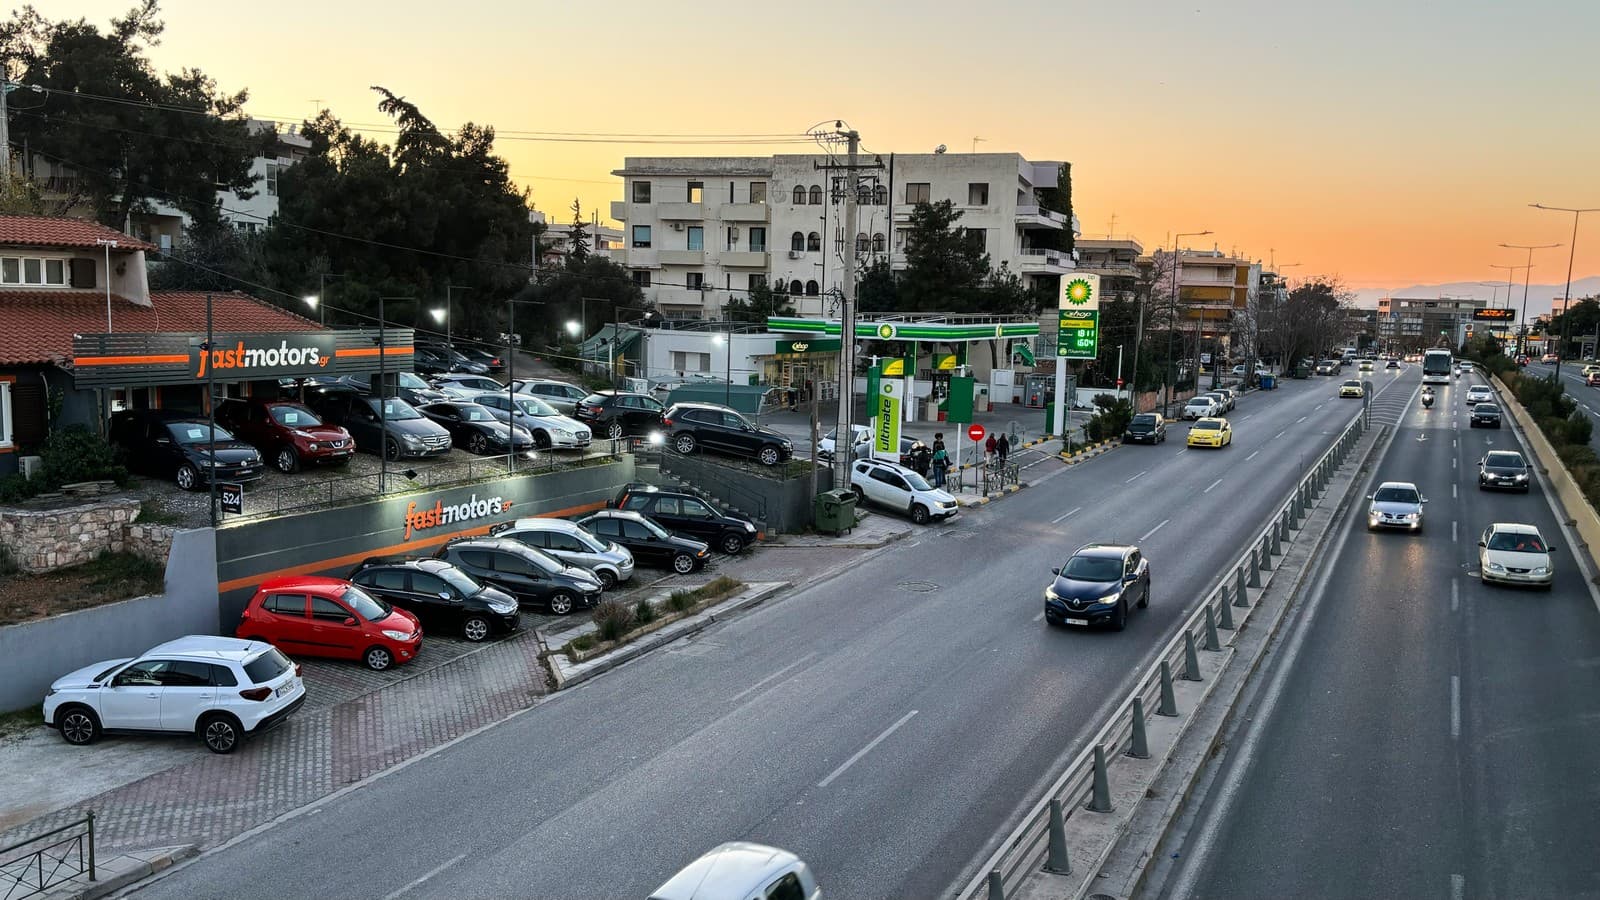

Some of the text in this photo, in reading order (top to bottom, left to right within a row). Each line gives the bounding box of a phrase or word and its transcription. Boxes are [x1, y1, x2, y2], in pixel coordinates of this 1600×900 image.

[880, 399, 891, 451] ultimate
[223, 492, 240, 505] 524
[403, 493, 513, 541] fastmotors.gr
